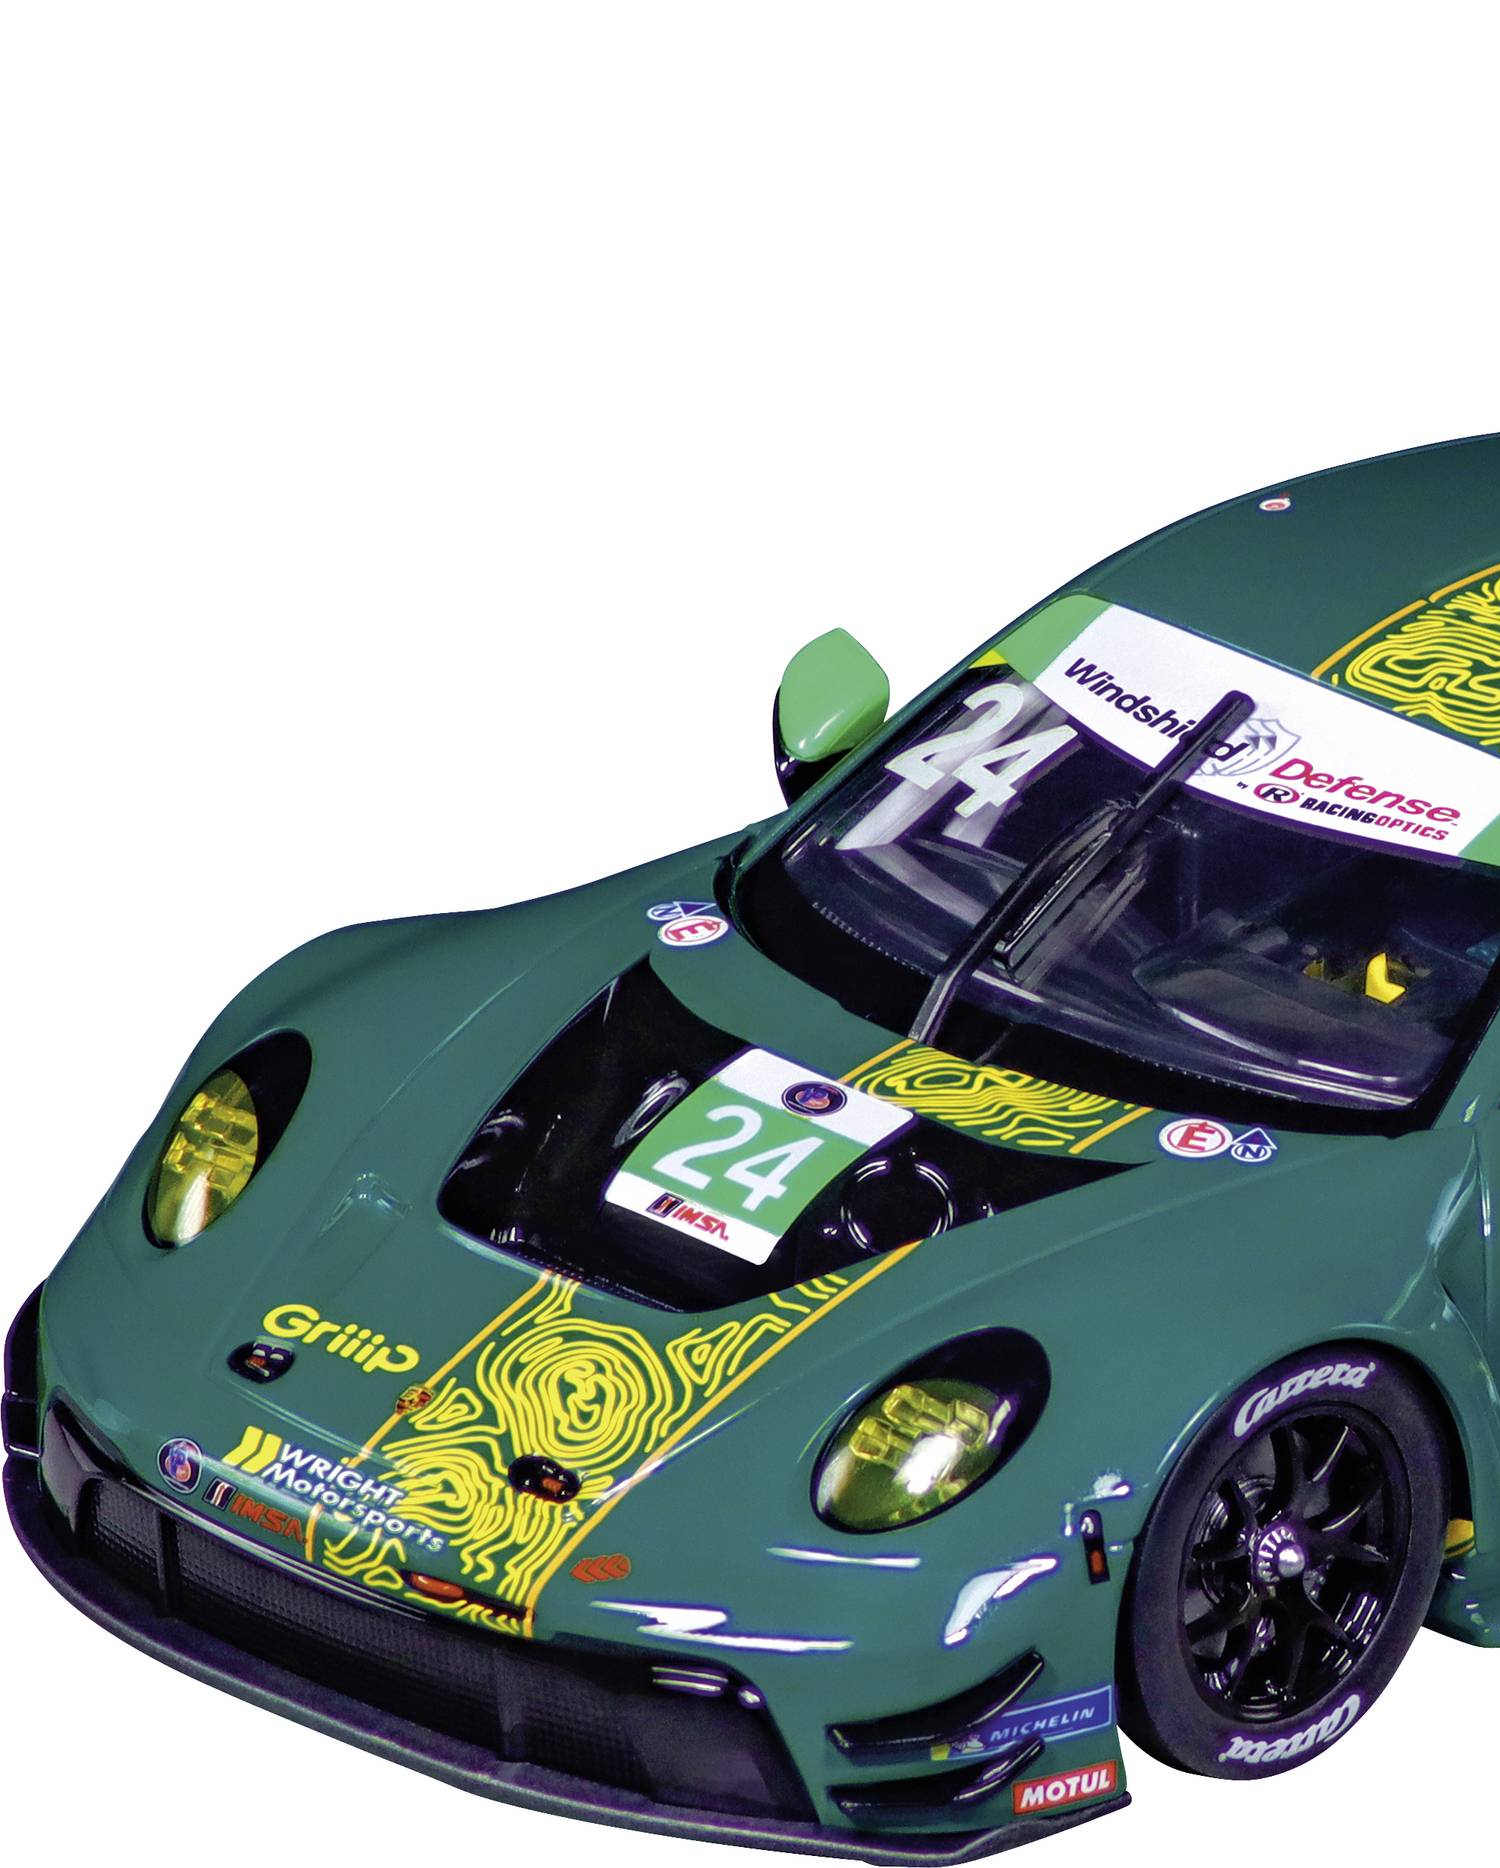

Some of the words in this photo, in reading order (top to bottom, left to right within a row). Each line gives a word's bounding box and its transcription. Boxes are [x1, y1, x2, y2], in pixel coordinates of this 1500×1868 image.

[884, 683, 1078, 818] 24
[1065, 657, 1250, 762] Windshid
[1268, 758, 1461, 822] Defense
[652, 1104, 825, 1210] 24
[672, 1205, 729, 1241] IMSA
[263, 1304, 420, 1373] Griiip
[1233, 1361, 1376, 1438] Carrera
[261, 1462, 445, 1552] Motorsports
[280, 1443, 405, 1506] WRIGHT
[231, 1493, 305, 1543] IMSA
[990, 1707, 1095, 1742] MICHELIN
[1218, 1694, 1361, 1764] Carrera
[1020, 1769, 1111, 1808] MOTUL
